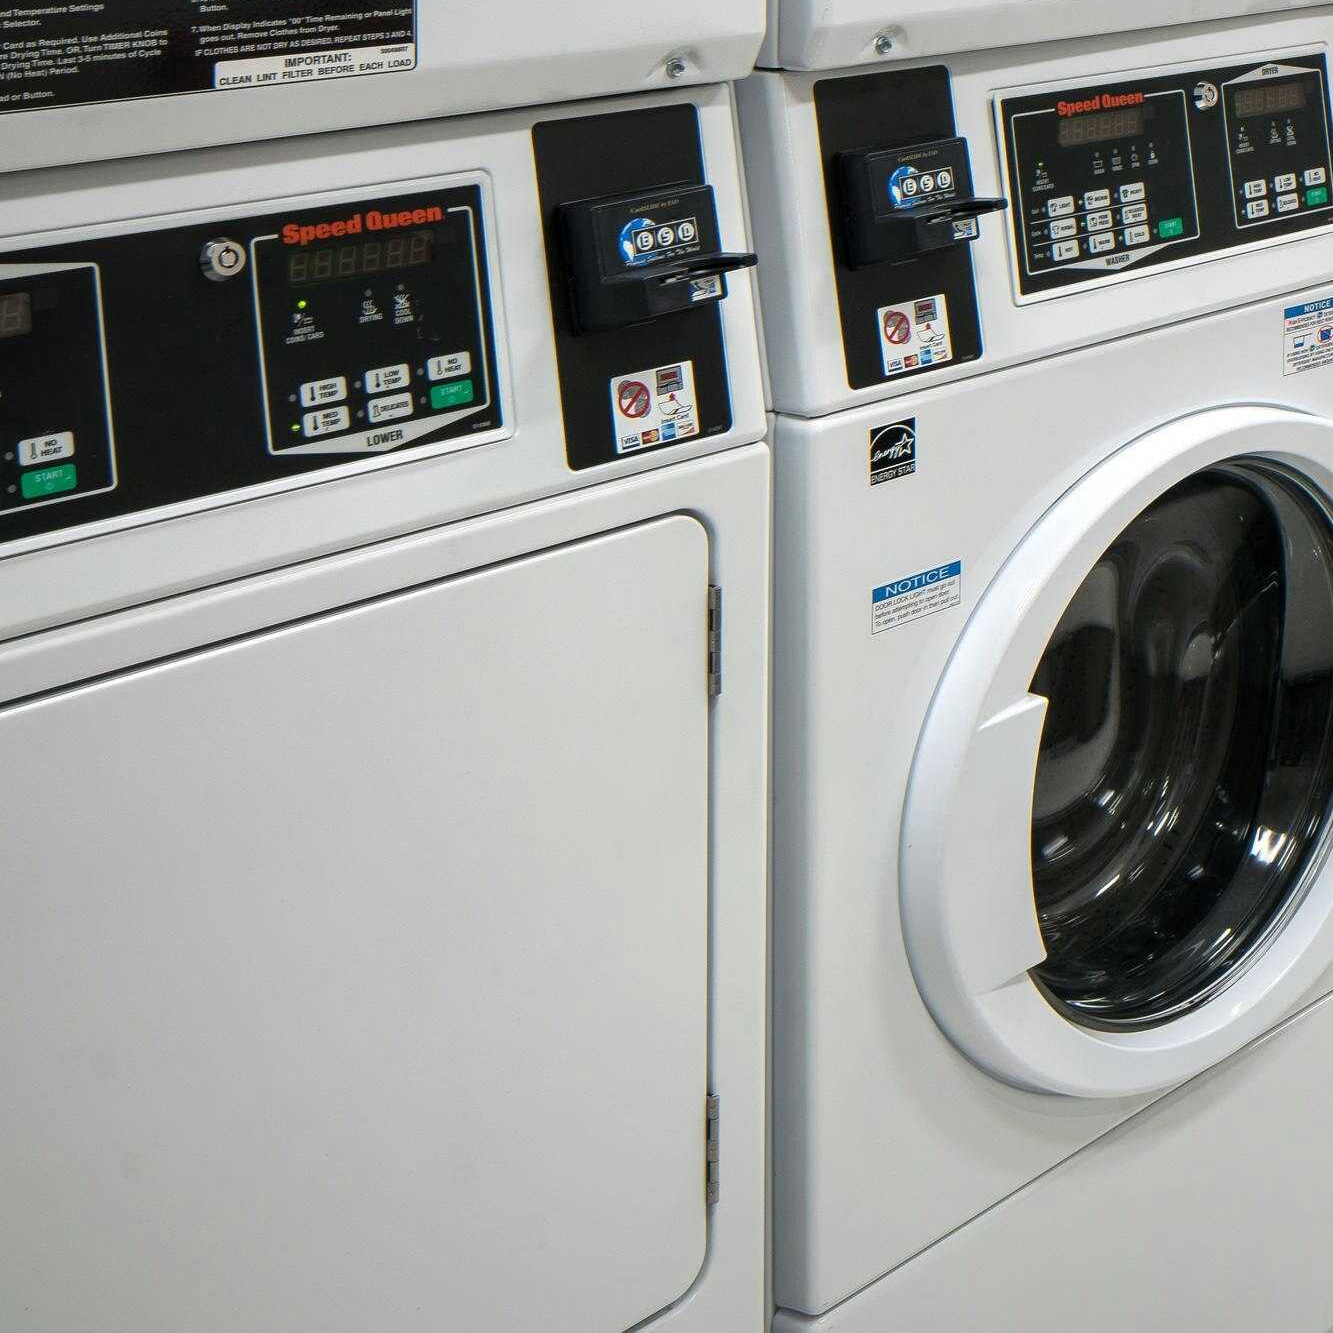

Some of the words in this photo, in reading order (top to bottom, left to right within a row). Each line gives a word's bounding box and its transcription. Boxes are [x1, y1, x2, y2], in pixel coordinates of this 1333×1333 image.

[12, 6, 68, 16] Temperature
[68, 3, 104, 12] Settings
[199, 4, 229, 12] Button.
[198, 24, 222, 32] When
[222, 22, 252, 30] Display
[252, 19, 287, 27] Indicates
[324, 12, 363, 21] Remaining
[372, 9, 394, 17] Panel
[393, 7, 412, 16] Light
[199, 35, 220, 44] goes
[236, 31, 268, 39] Remove
[268, 28, 298, 36] Clothes
[317, 24, 340, 32] Dryer.
[203, 45, 239, 55] CLOTHES
[239, 44, 256, 52] ARE
[256, 42, 272, 50] NOT
[272, 41, 288, 49] DRY
[288, 39, 300, 47] AS
[333, 34, 361, 43] REPEAT
[361, 32, 384, 40] STEPS
[284, 53, 352, 67] IMPORTANT:
[219, 75, 252, 85] CLEAN
[256, 72, 278, 82] LINT
[282, 68, 313, 79] FILTER
[317, 64, 355, 75] BEFORE
[358, 61, 384, 71] EACH
[387, 58, 412, 68] LOAD
[1057, 96, 1100, 116] Speed
[1102, 92, 1144, 108] Queen
[903, 170, 951, 195] ESD
[282, 213, 362, 245] Speed
[366, 206, 442, 232] Queen
[637, 222, 696, 250] ESD
[1106, 254, 1130, 266] WASHER
[1304, 300, 1330, 312] NOTICE
[384, 370, 400, 378] LOW
[445, 364, 462, 373] HEAT
[319, 383, 337, 391] HIGH
[384, 377, 402, 386] TEMP
[319, 390, 338, 399] TEMP
[440, 385, 462, 395] START
[380, 400, 410, 413] DELICATES
[323, 411, 338, 419] MED
[322, 418, 341, 427] TEMP
[44, 438, 57, 447] NO
[367, 430, 404, 447] LOWER
[624, 436, 639, 444] VISA
[40, 447, 62, 456] HEAT
[35, 470, 63, 482] START
[872, 470, 896, 483] ENERGY
[898, 464, 915, 475] STAR
[886, 566, 949, 597] NOTICE
[876, 600, 892, 611] DOOR
[894, 595, 908, 607] LOCK
[910, 589, 925, 599] LIGHT
[927, 586, 939, 594] must
[875, 610, 891, 620] before
[892, 600, 918, 614] attempting
[926, 594, 937, 602] open
[898, 611, 910, 621] push
